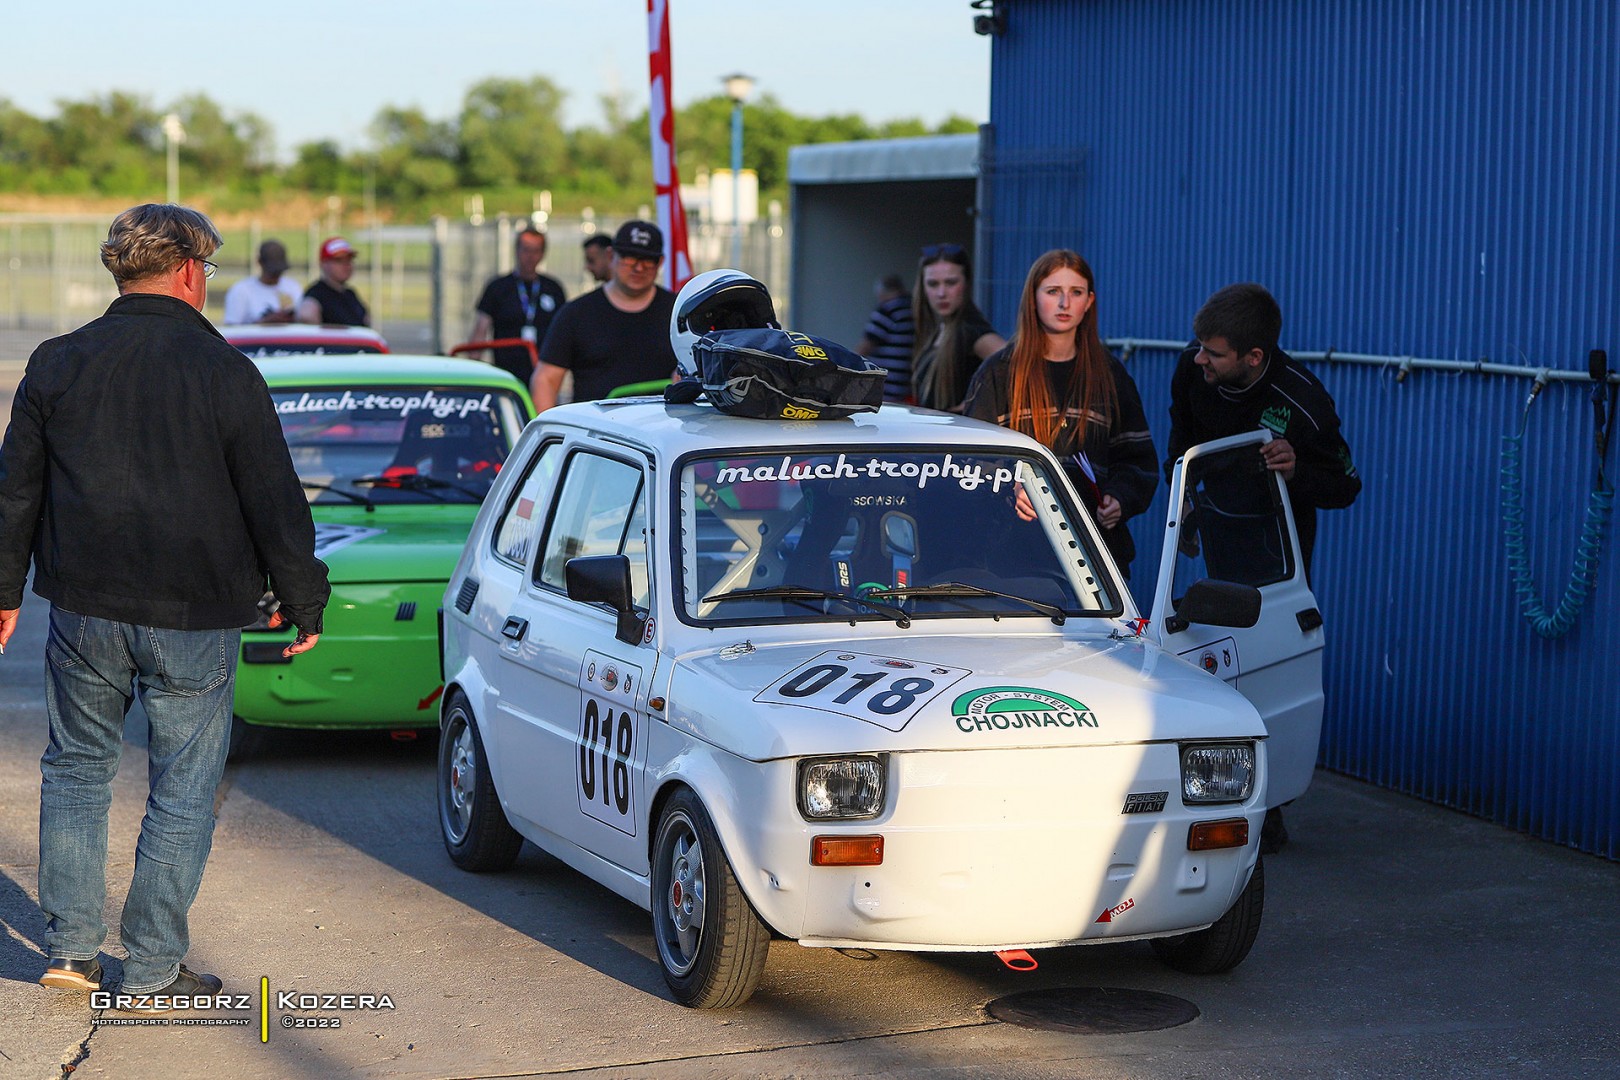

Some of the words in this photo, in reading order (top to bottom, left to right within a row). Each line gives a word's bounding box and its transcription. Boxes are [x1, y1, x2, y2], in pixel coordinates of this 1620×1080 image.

[792, 345, 828, 359] OMP
[274, 390, 492, 419] aluch-trophy.pl
[781, 404, 820, 420] OMP
[716, 453, 1026, 493] maluch-trophy.pl
[778, 664, 935, 715] 018
[971, 691, 1002, 715] MOTOR
[1012, 691, 1070, 713] SYSTEM
[956, 711, 1100, 733] CHOJNACKI
[580, 698, 633, 816] 018
[1126, 802, 1164, 813] FIAT
[1128, 793, 1168, 803] POLSKI
[1110, 898, 1136, 919] TOW
